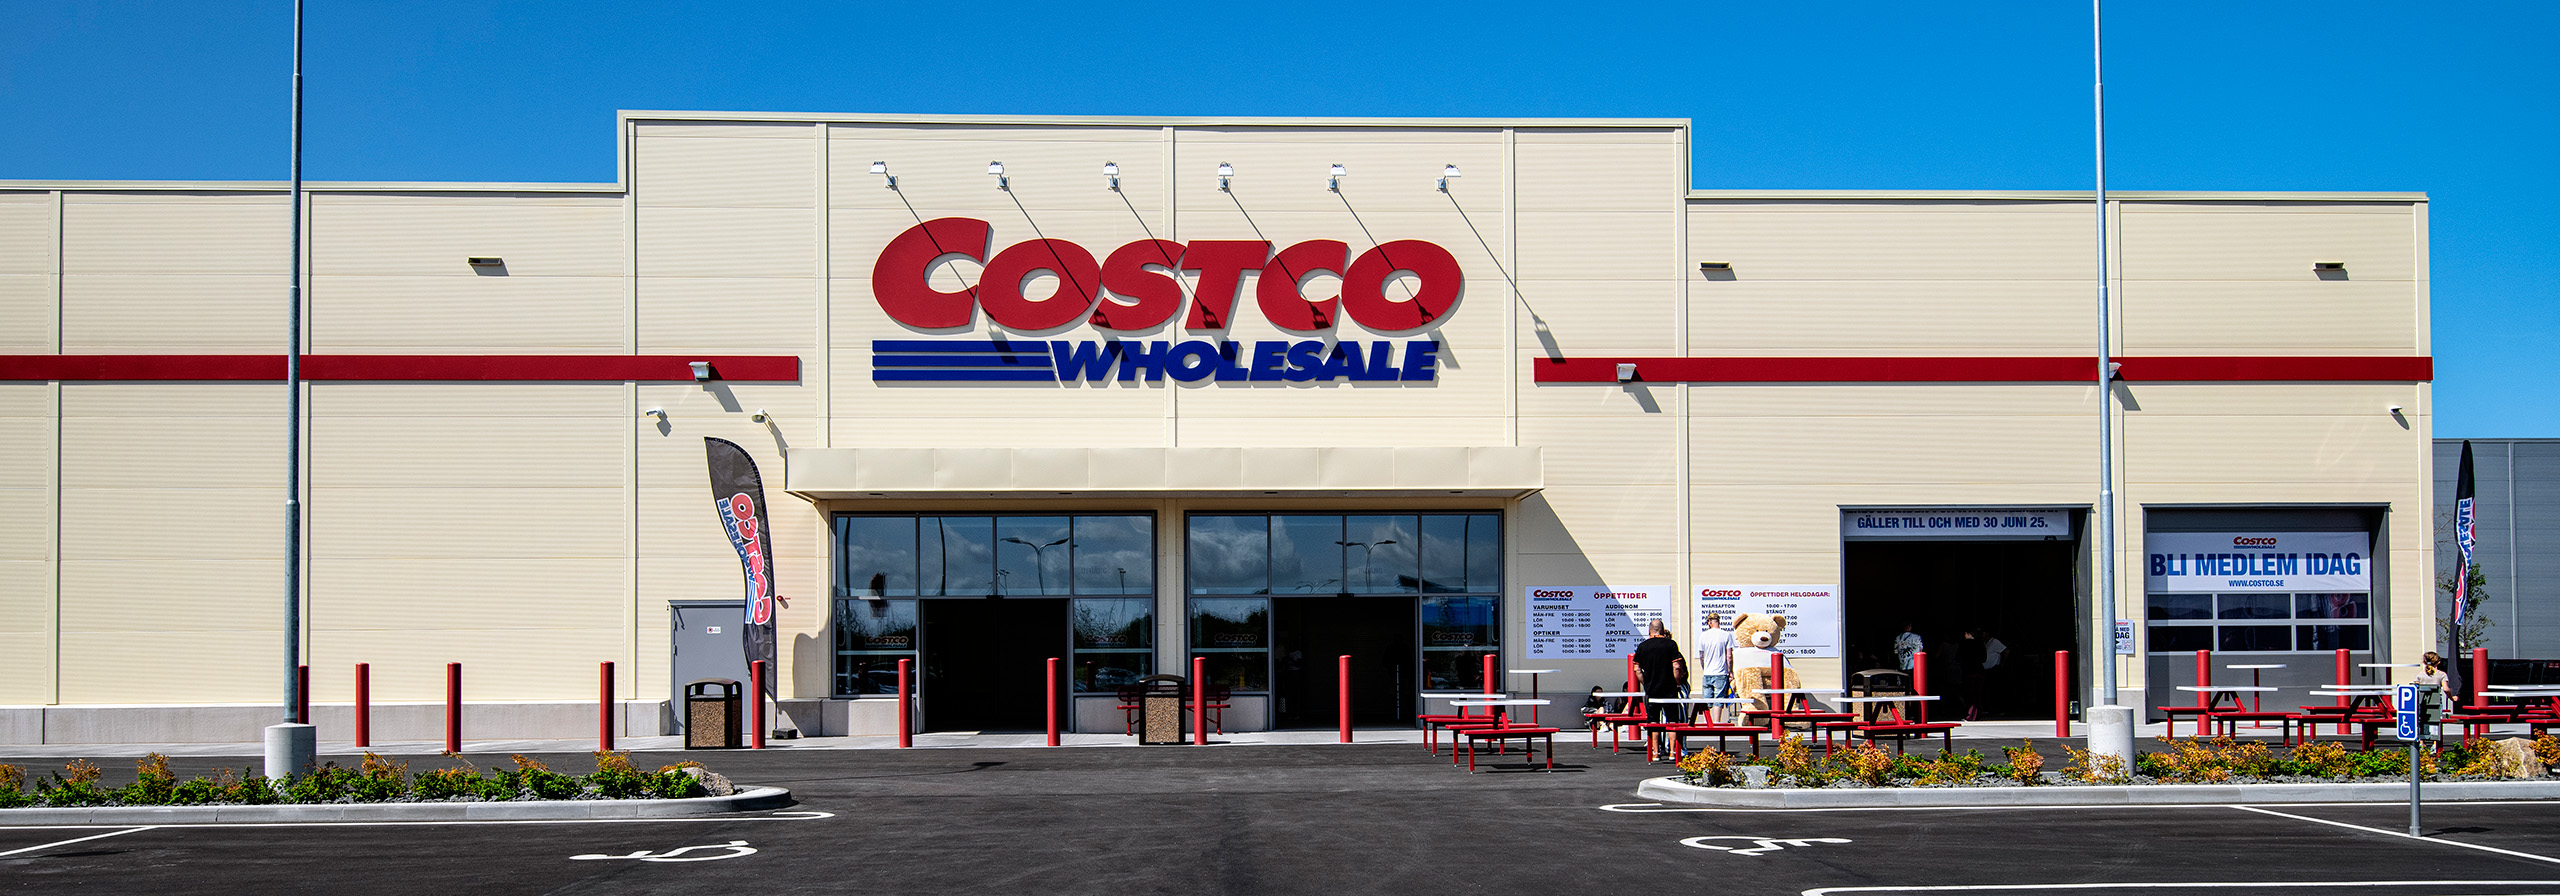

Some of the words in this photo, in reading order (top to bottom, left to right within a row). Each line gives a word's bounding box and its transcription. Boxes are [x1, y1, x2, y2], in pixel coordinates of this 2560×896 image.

[872, 217, 1462, 331] COSTCO
[1050, 340, 1440, 381] WHOLESALE
[1857, 514, 1900, 528] GÄLLER
[1902, 517, 1926, 528] TILL
[1928, 516, 1952, 528] OCH
[1954, 516, 1980, 528] MED
[1983, 516, 1998, 528] 30
[2001, 516, 2027, 528] JUNI
[2029, 516, 2049, 528] 25.
[2233, 536, 2277, 545] COSTCO
[2150, 553, 2187, 576] BLI
[2195, 553, 2298, 576] MEDLEM
[2305, 552, 2361, 576] IDAG
[1533, 589, 1573, 598] COSTCO
[1593, 591, 1647, 599] ÖPPETTIDER
[1702, 588, 1742, 597] COSTCO
[2401, 688, 2412, 709] P
